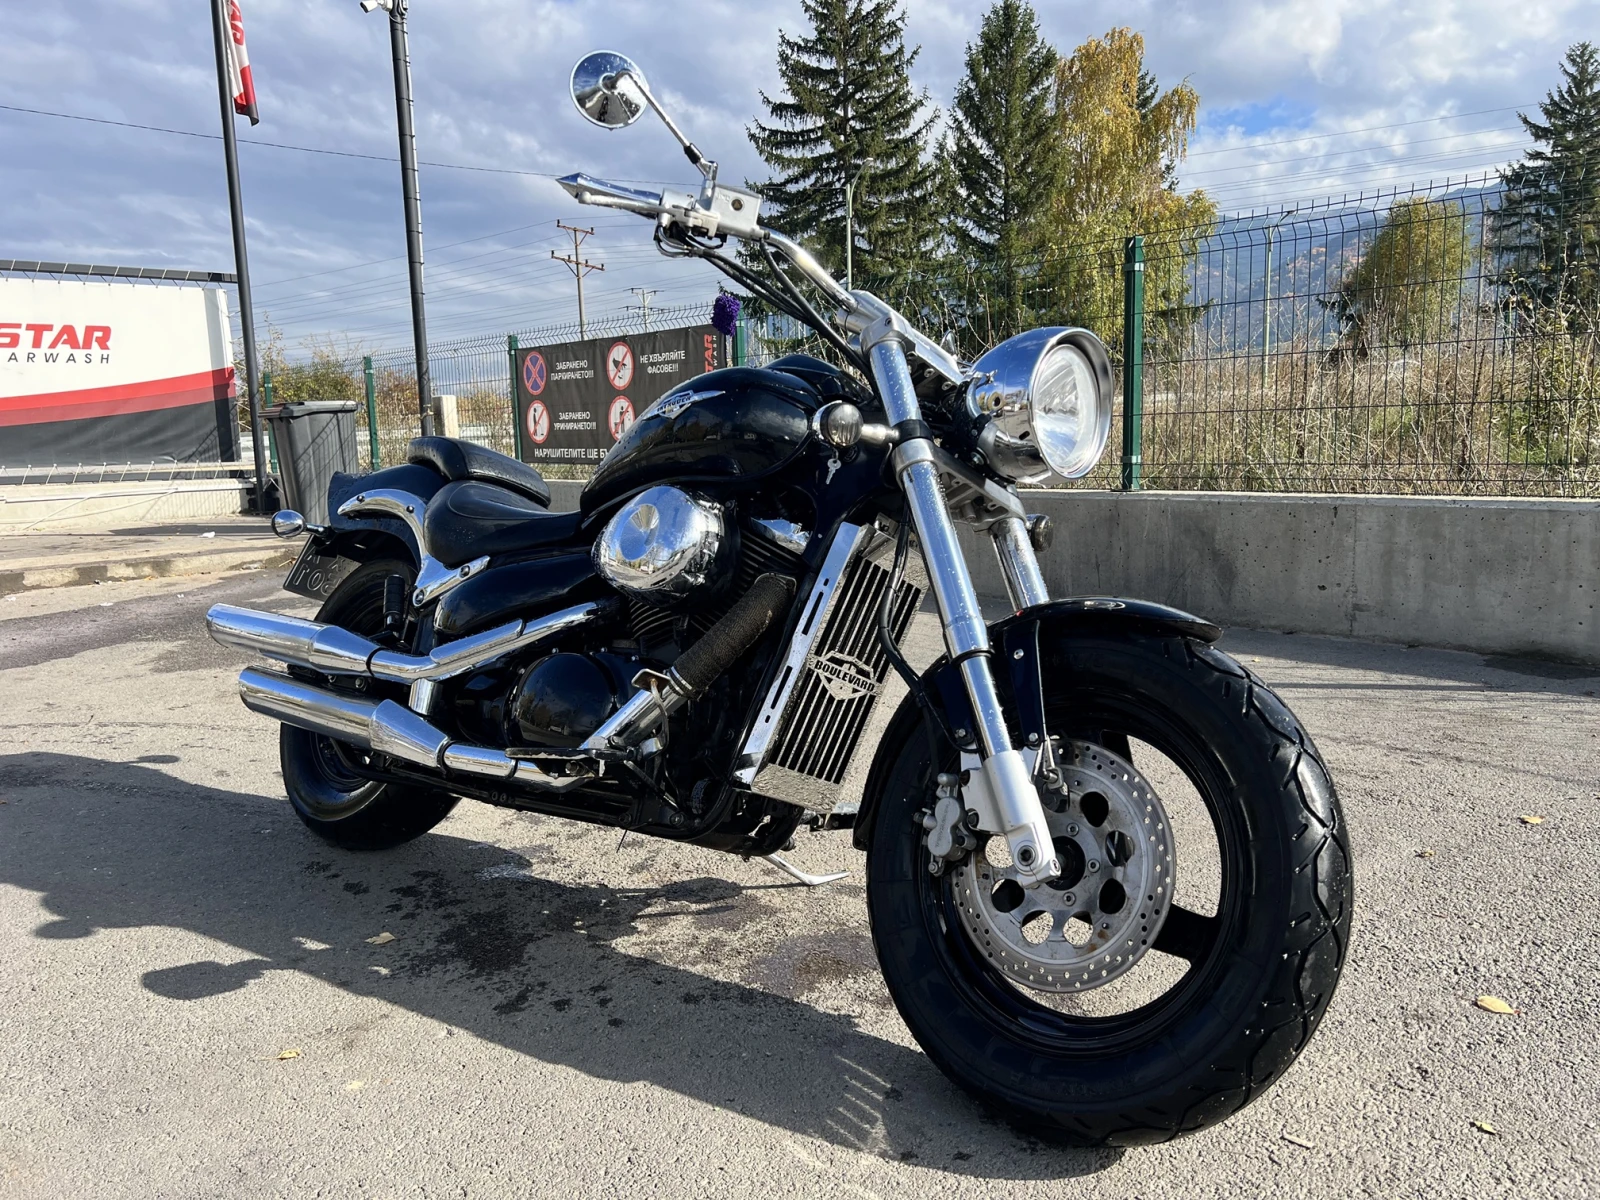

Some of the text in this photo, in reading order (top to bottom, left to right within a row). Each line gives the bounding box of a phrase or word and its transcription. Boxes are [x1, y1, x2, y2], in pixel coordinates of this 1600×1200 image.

[0, 323, 112, 350] STAR
[7, 352, 110, 364] ARWASH
[640, 350, 686, 364] НЕ ХВЪРЛЯЙТЕ
[704, 334, 714, 373] TAR
[555, 360, 588, 370] ЗАБРАНЕНО
[558, 411, 591, 420] ЗАБРАНЕНО
[534, 448, 586, 458] НАРУШИТЕЛИТЕ
[586, 448, 599, 460] ЩЕ
[814, 660, 876, 692] BOULEVARD
